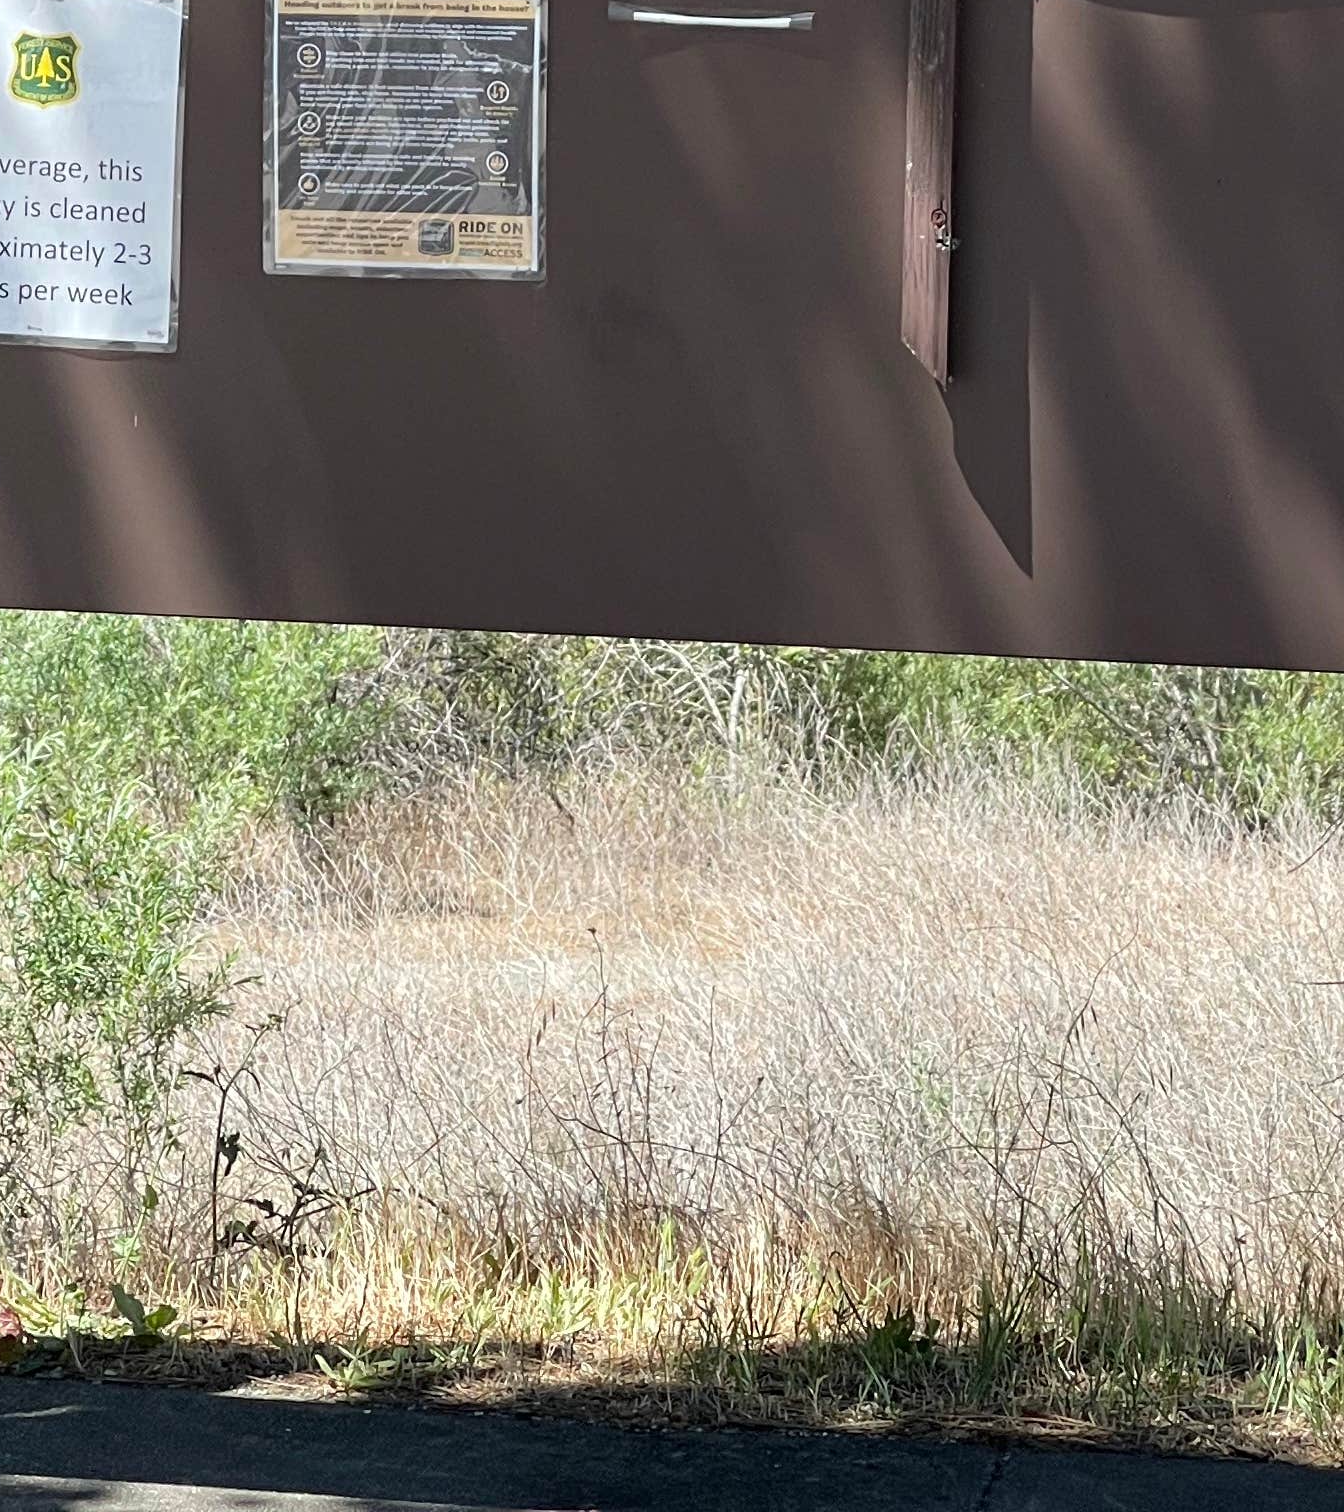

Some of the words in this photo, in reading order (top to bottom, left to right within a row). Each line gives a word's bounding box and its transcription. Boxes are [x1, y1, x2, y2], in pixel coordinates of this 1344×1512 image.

[99, 159, 143, 181] this
[23, 195, 41, 218] is
[50, 197, 146, 224] cleaned
[458, 221, 496, 233] RIDE
[500, 222, 523, 234] ON
[113, 242, 152, 266] 2-3
[484, 248, 523, 258] ACCESS
[18, 284, 59, 305] per
[68, 283, 133, 306] week
